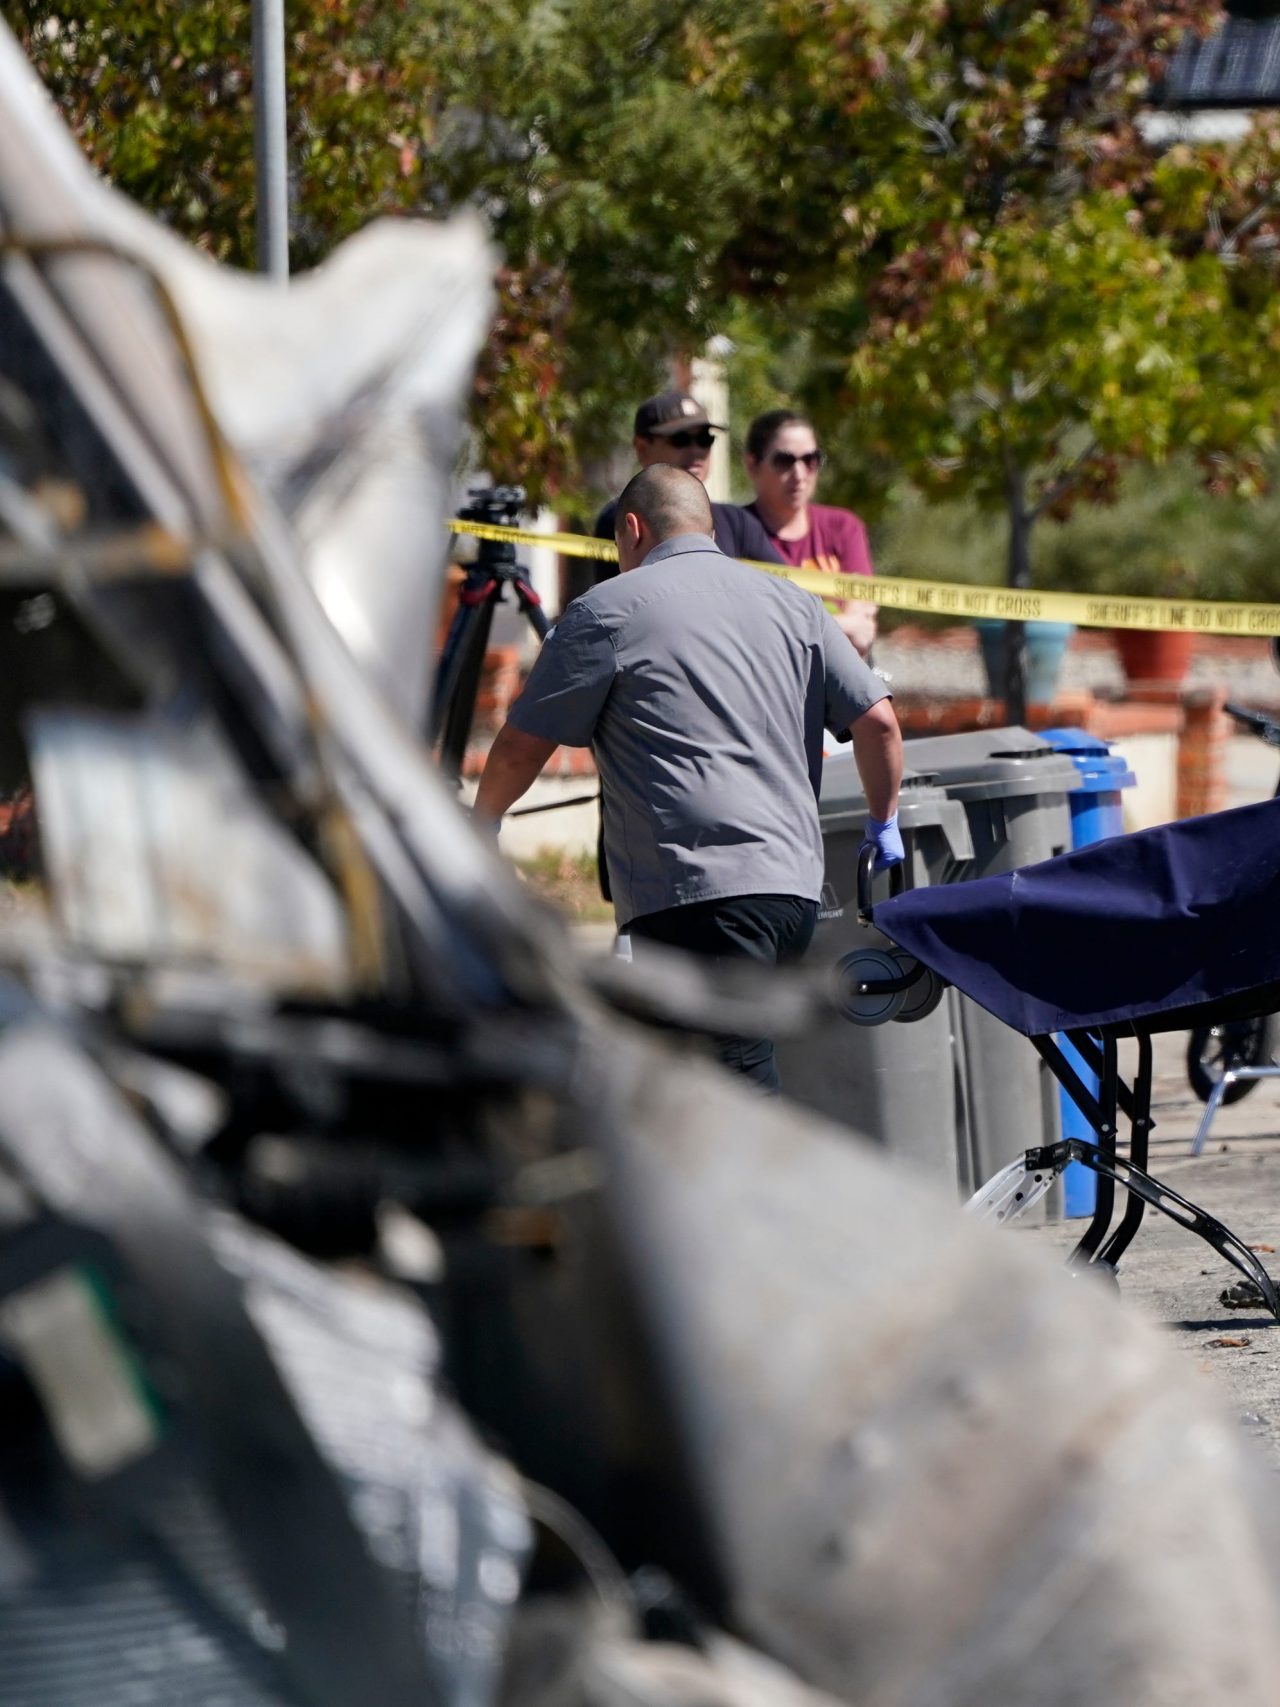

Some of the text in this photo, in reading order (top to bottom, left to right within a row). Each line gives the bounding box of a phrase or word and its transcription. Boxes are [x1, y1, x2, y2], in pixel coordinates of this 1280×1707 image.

[833, 578, 900, 605] SHERIFF'S
[941, 587, 959, 609] DO
[964, 590, 990, 611] NOT
[997, 593, 1041, 617] CROSS
[1086, 601, 1153, 625] SHERIFF'S
[1193, 606, 1211, 627] DO
[1216, 607, 1244, 629] NOT
